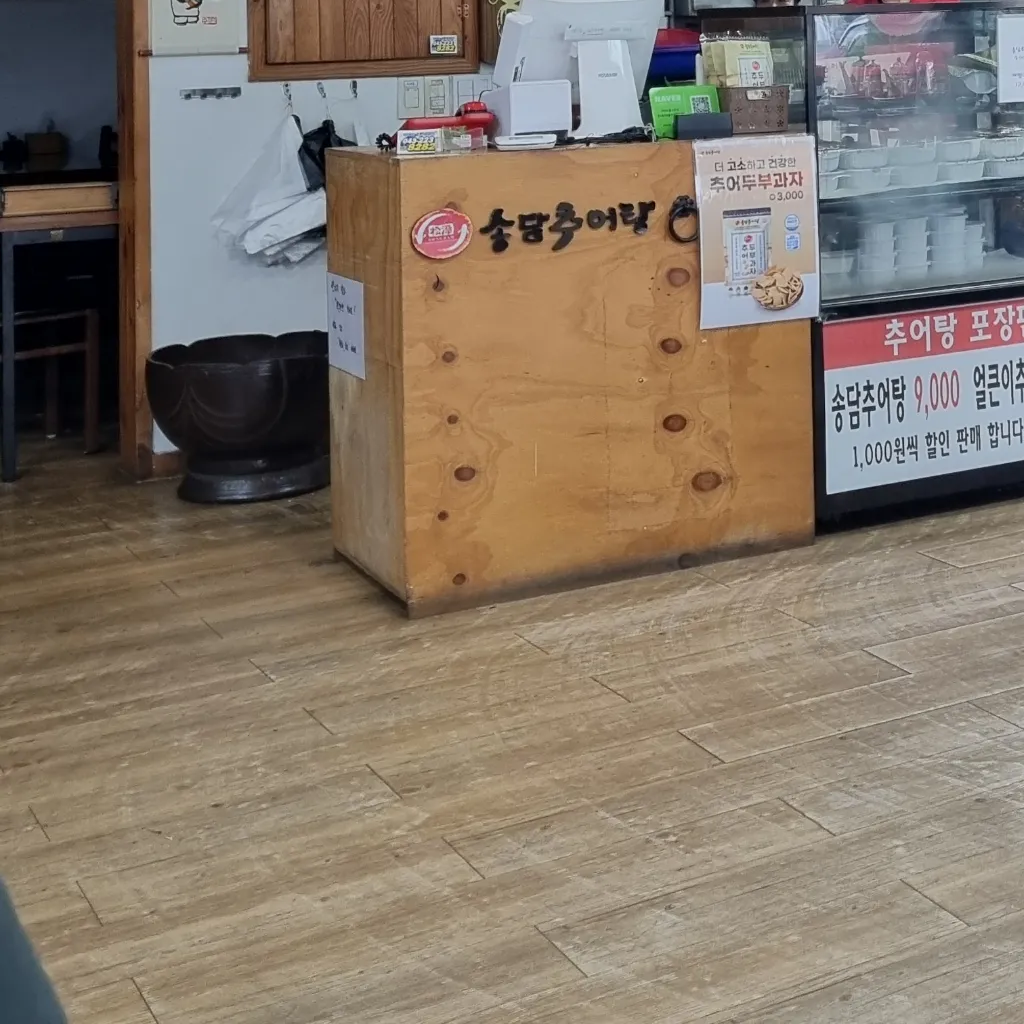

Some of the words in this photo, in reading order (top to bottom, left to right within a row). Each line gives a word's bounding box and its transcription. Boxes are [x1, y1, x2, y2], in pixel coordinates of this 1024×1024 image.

[710, 171, 804, 193] 추어두부과자
[714, 161, 723, 172] 더
[727, 159, 765, 172] 고소하고
[768, 157, 796, 169] 건강한
[479, 200, 656, 253] 송담추어탕
[884, 312, 957, 356] 추어탕
[831, 375, 906, 433] 송담추어탕
[914, 369, 960, 419] 9,000
[853, 434, 919, 471] 1,000원씩
[926, 429, 950, 459] 할인
[957, 425, 981, 453] 판매
